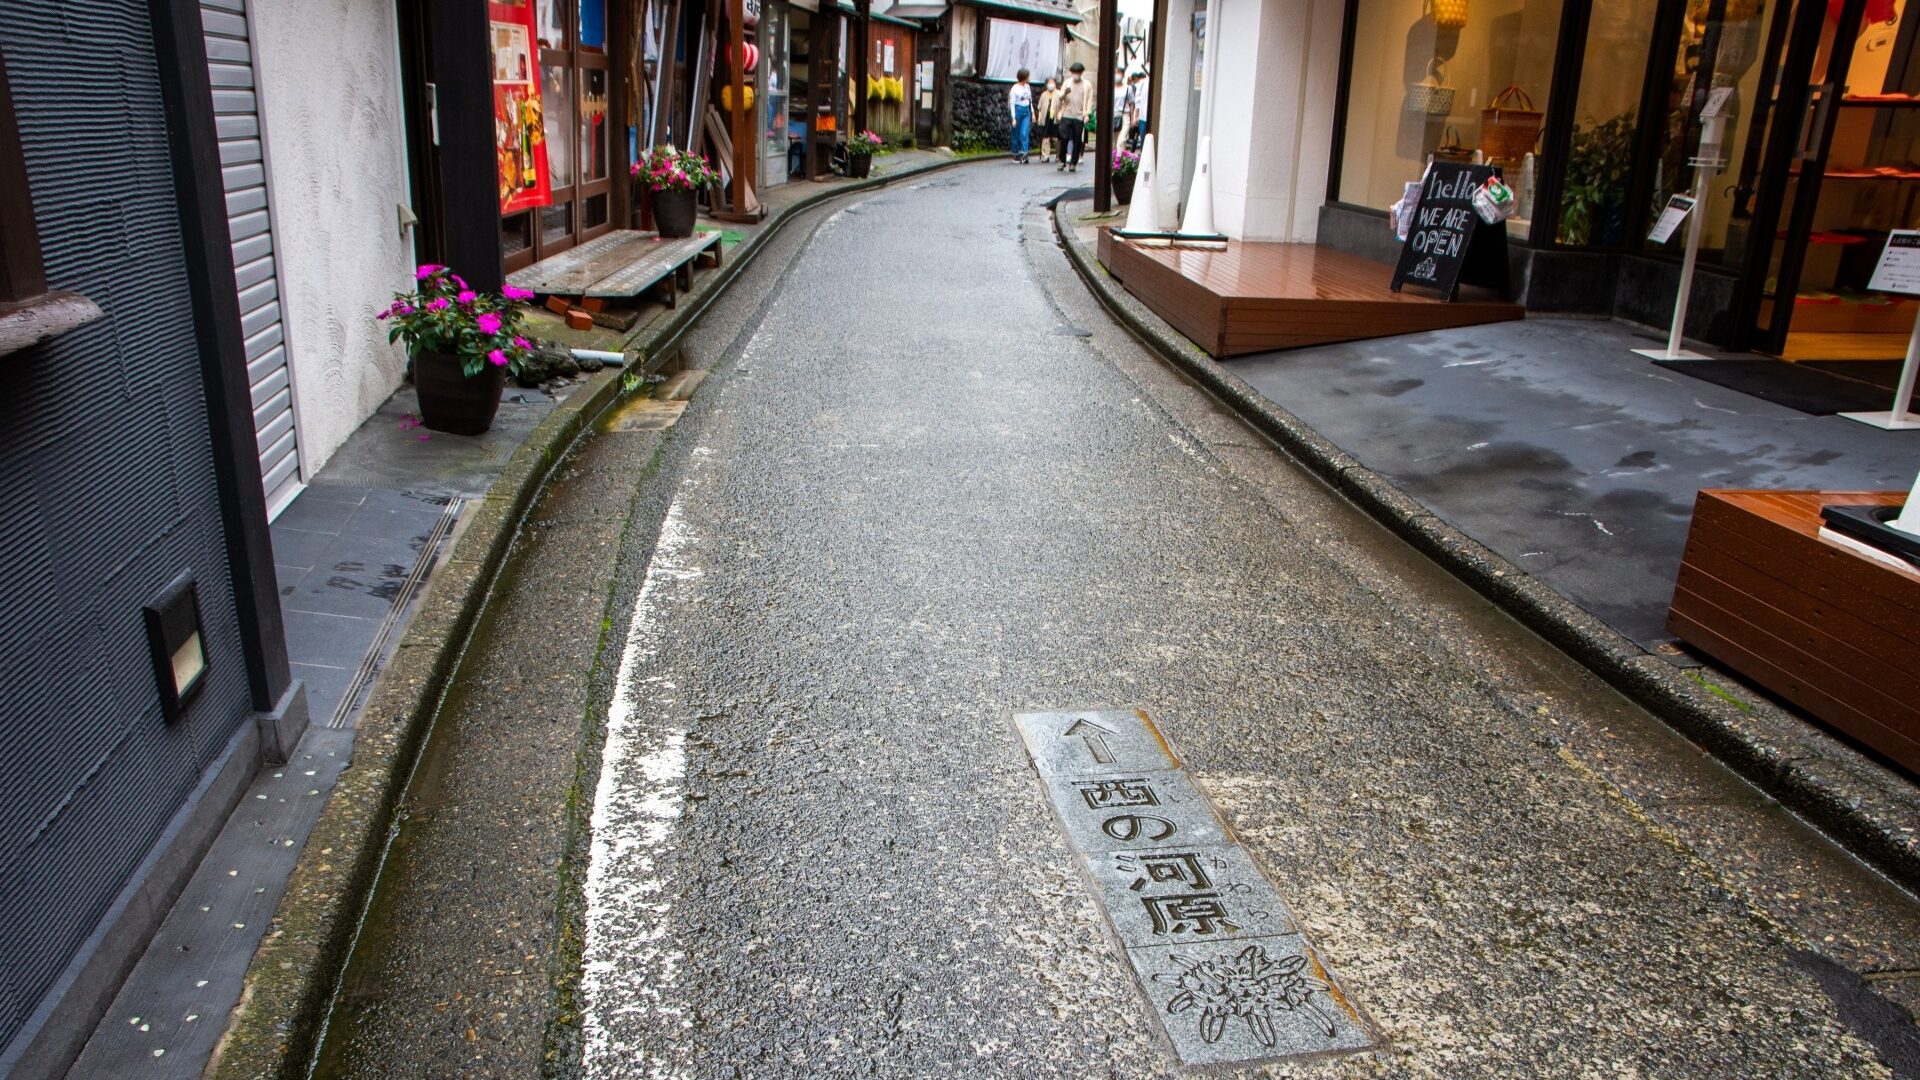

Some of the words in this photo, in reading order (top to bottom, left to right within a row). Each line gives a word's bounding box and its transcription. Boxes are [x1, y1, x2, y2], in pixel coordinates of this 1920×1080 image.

[1426, 170, 1477, 200] hello
[1419, 207, 1443, 227] WE
[1440, 208, 1471, 231] ARE
[1412, 230, 1463, 258] OPEN
[1071, 777, 1244, 937] 西の河原
